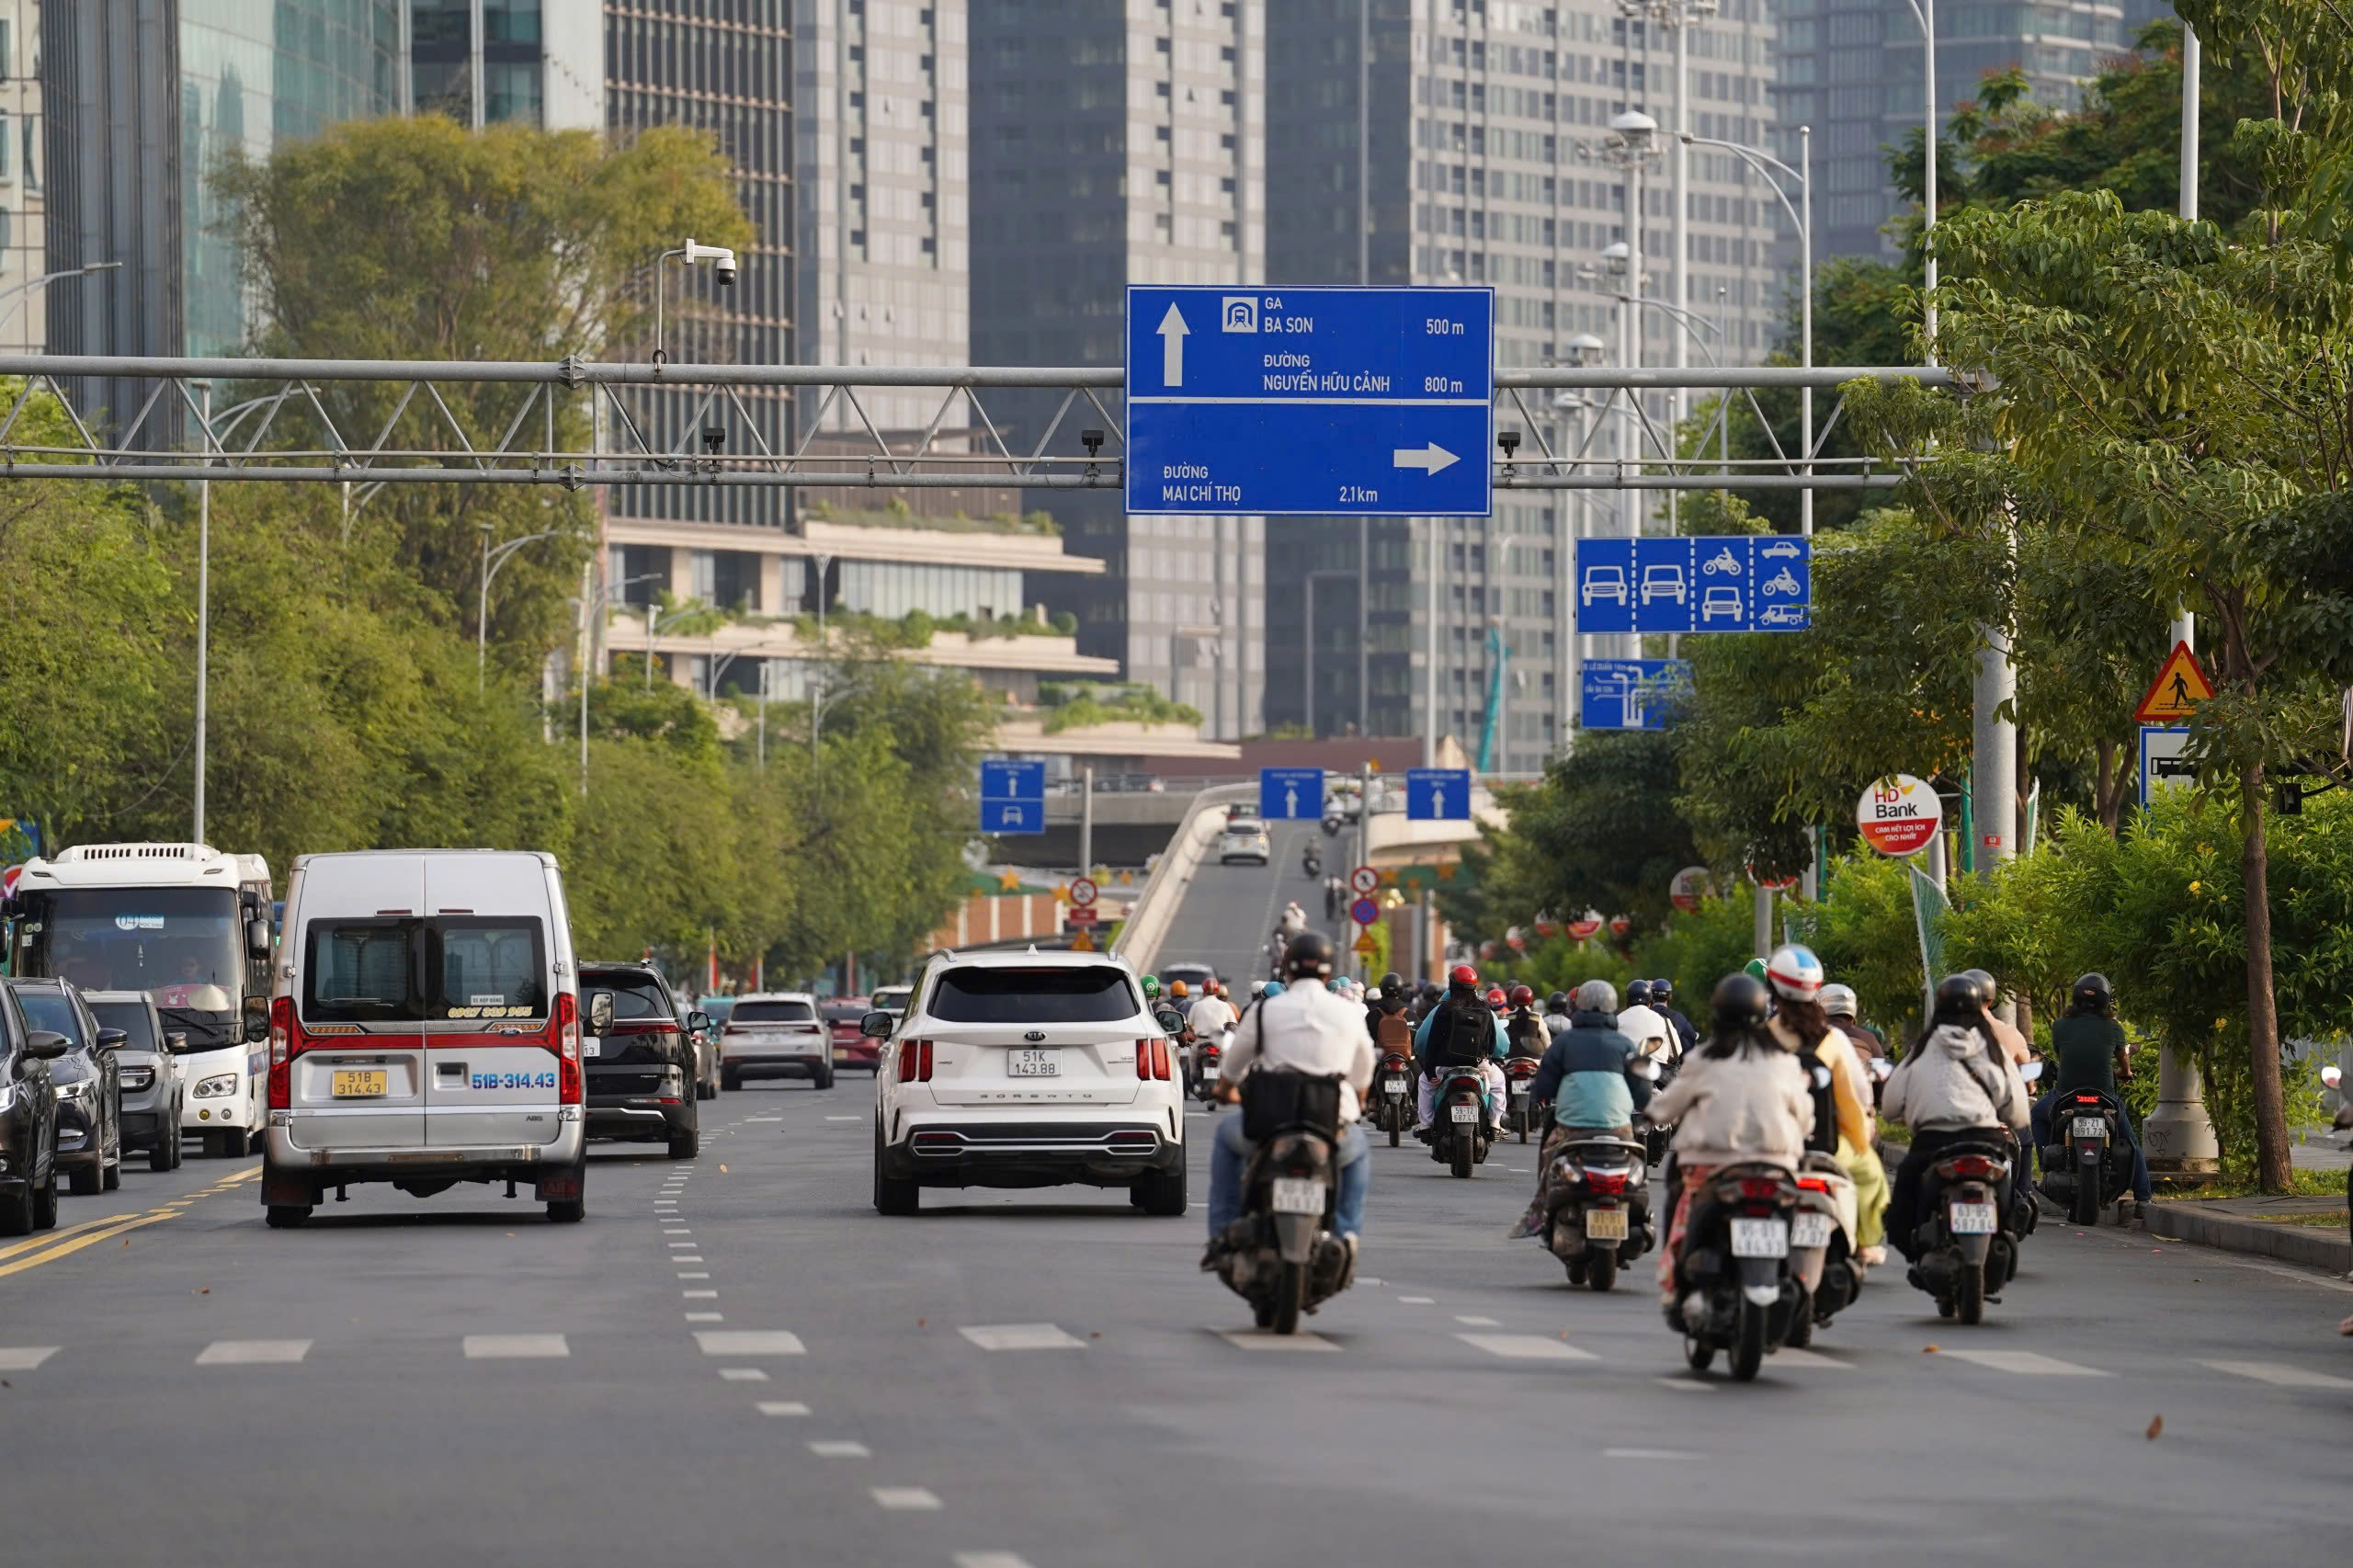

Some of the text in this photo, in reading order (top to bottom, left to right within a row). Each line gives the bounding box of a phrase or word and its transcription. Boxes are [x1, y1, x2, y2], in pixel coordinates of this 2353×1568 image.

[1265, 297, 1283, 310] GA
[1264, 316, 1313, 334] BA SON
[1426, 318, 1464, 335] 500 m
[1264, 350, 1311, 368] ĐƯỜNG
[1264, 369, 1391, 392] NGUYỄN HỮU CẢNH
[1425, 376, 1463, 393] 800 m
[1163, 460, 1209, 479] ĐƯỜNG
[1163, 481, 1241, 506] MAI CHÍ THỌ
[1874, 788, 1900, 803] HD
[1875, 802, 1918, 819] Bank
[1023, 1051, 1045, 1062] 51K
[1015, 1062, 1055, 1074] 143.88
[347, 1072, 371, 1083] 51B
[472, 1072, 555, 1089] 51B-314.43
[338, 1084, 381, 1095] 314.43
